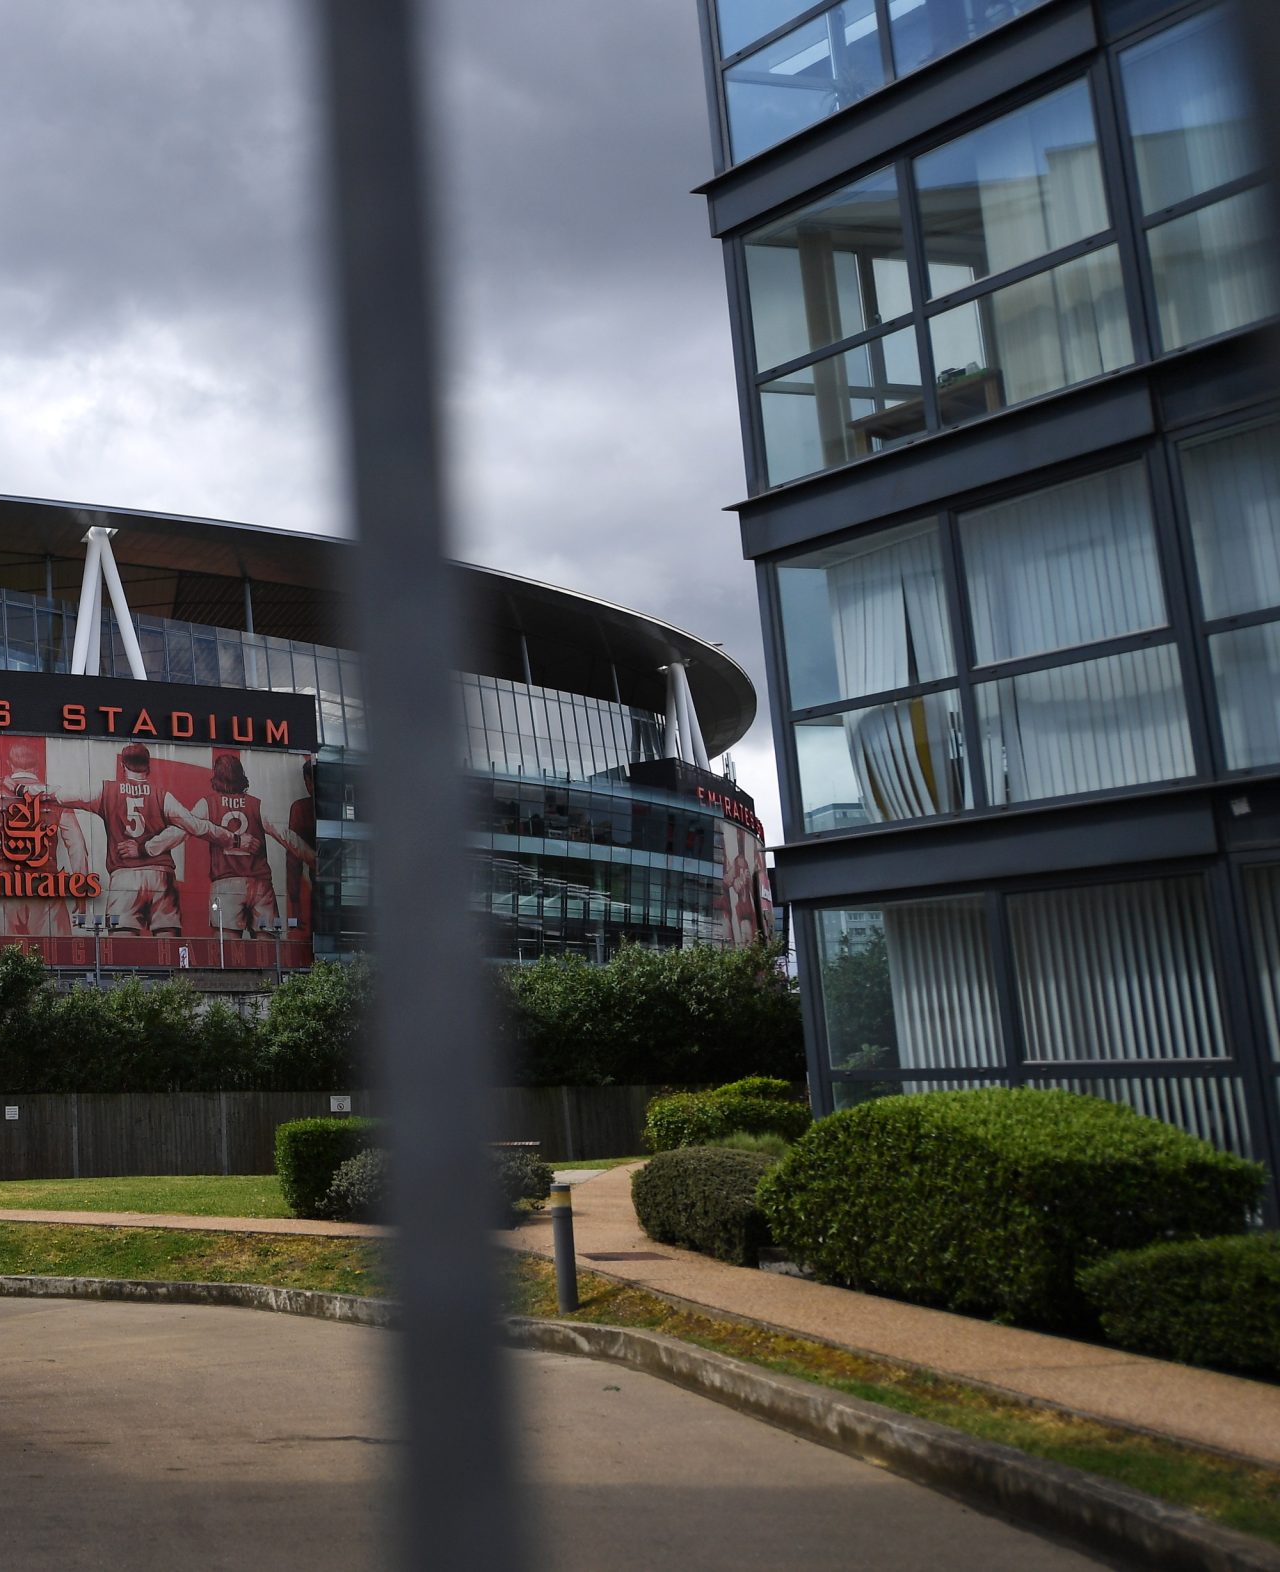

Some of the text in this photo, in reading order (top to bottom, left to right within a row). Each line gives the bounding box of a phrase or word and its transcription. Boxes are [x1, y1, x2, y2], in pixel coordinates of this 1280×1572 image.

[62, 704, 289, 745] STADIUM
[120, 783, 151, 796] BOULD
[221, 796, 246, 809] RICE
[697, 786, 756, 830] EMIRATES
[125, 797, 146, 838] 5
